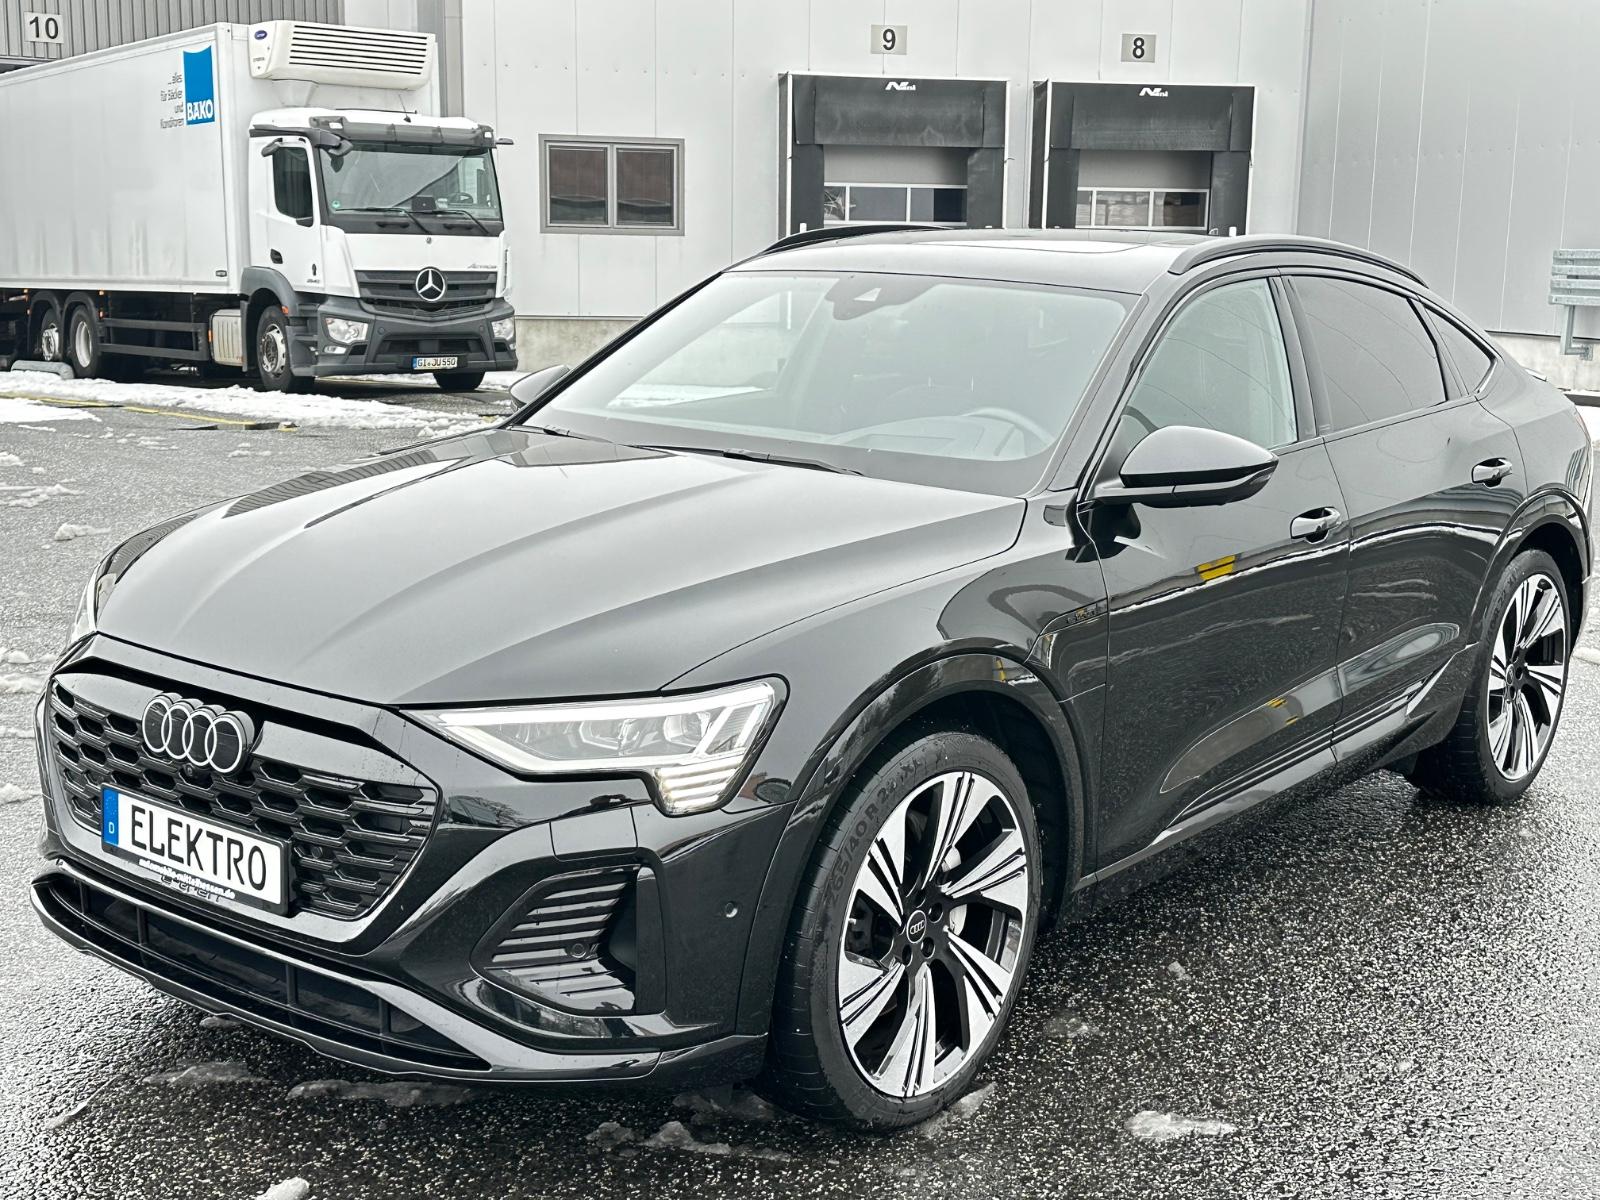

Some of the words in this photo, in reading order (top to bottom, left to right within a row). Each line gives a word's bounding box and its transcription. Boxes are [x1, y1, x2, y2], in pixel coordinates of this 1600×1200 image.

[29, 16, 59, 39] 10
[882, 28, 896, 51] 9
[1131, 36, 1146, 59] 8
[108, 821, 115, 834] D
[131, 804, 267, 891] ELEKTRO
